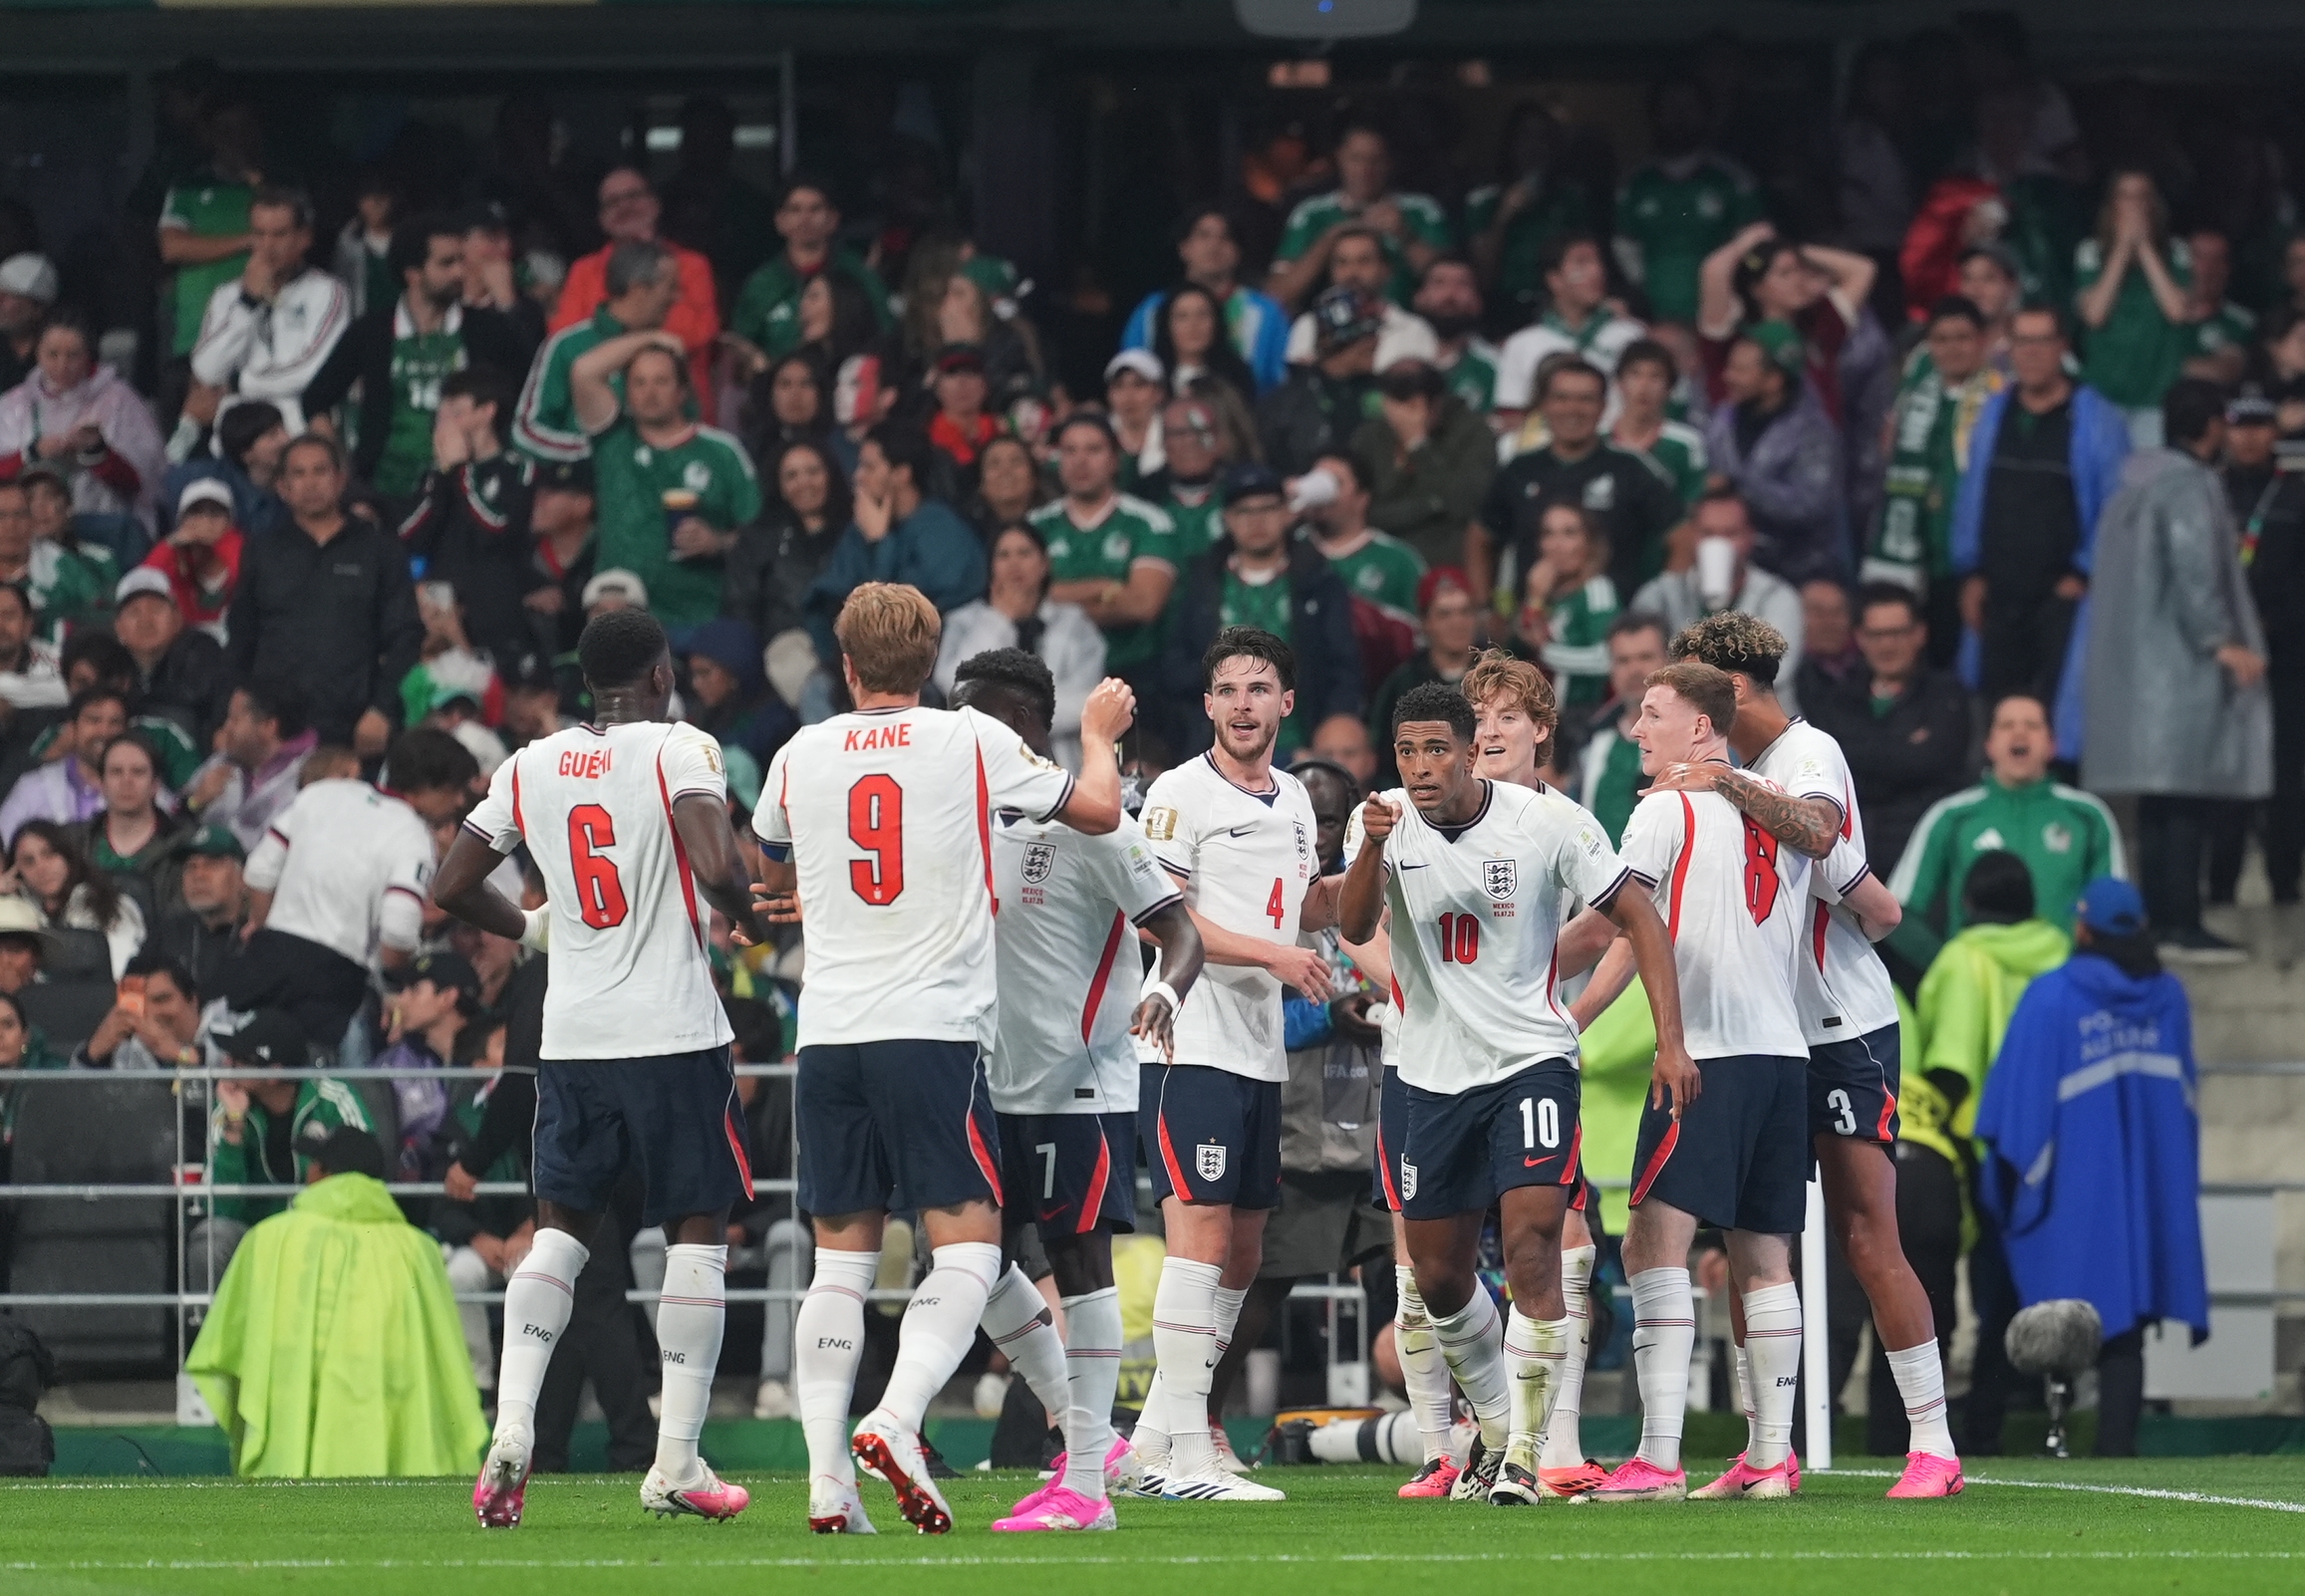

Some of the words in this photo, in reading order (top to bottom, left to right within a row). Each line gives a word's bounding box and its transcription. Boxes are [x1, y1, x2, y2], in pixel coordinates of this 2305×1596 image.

[843, 723, 912, 752] KANE
[848, 773, 904, 906] 9
[567, 803, 629, 931] 6
[1743, 810, 1779, 929] 8
[1266, 877, 1285, 930] 4
[1438, 912, 1480, 965] 10
[1519, 1097, 1561, 1149] 10
[1827, 1088, 1858, 1136] 3
[1034, 1142, 1057, 1199] 7
[522, 1322, 553, 1343] ENG
[662, 1349, 686, 1365] ENG
[817, 1336, 853, 1351] ENG
